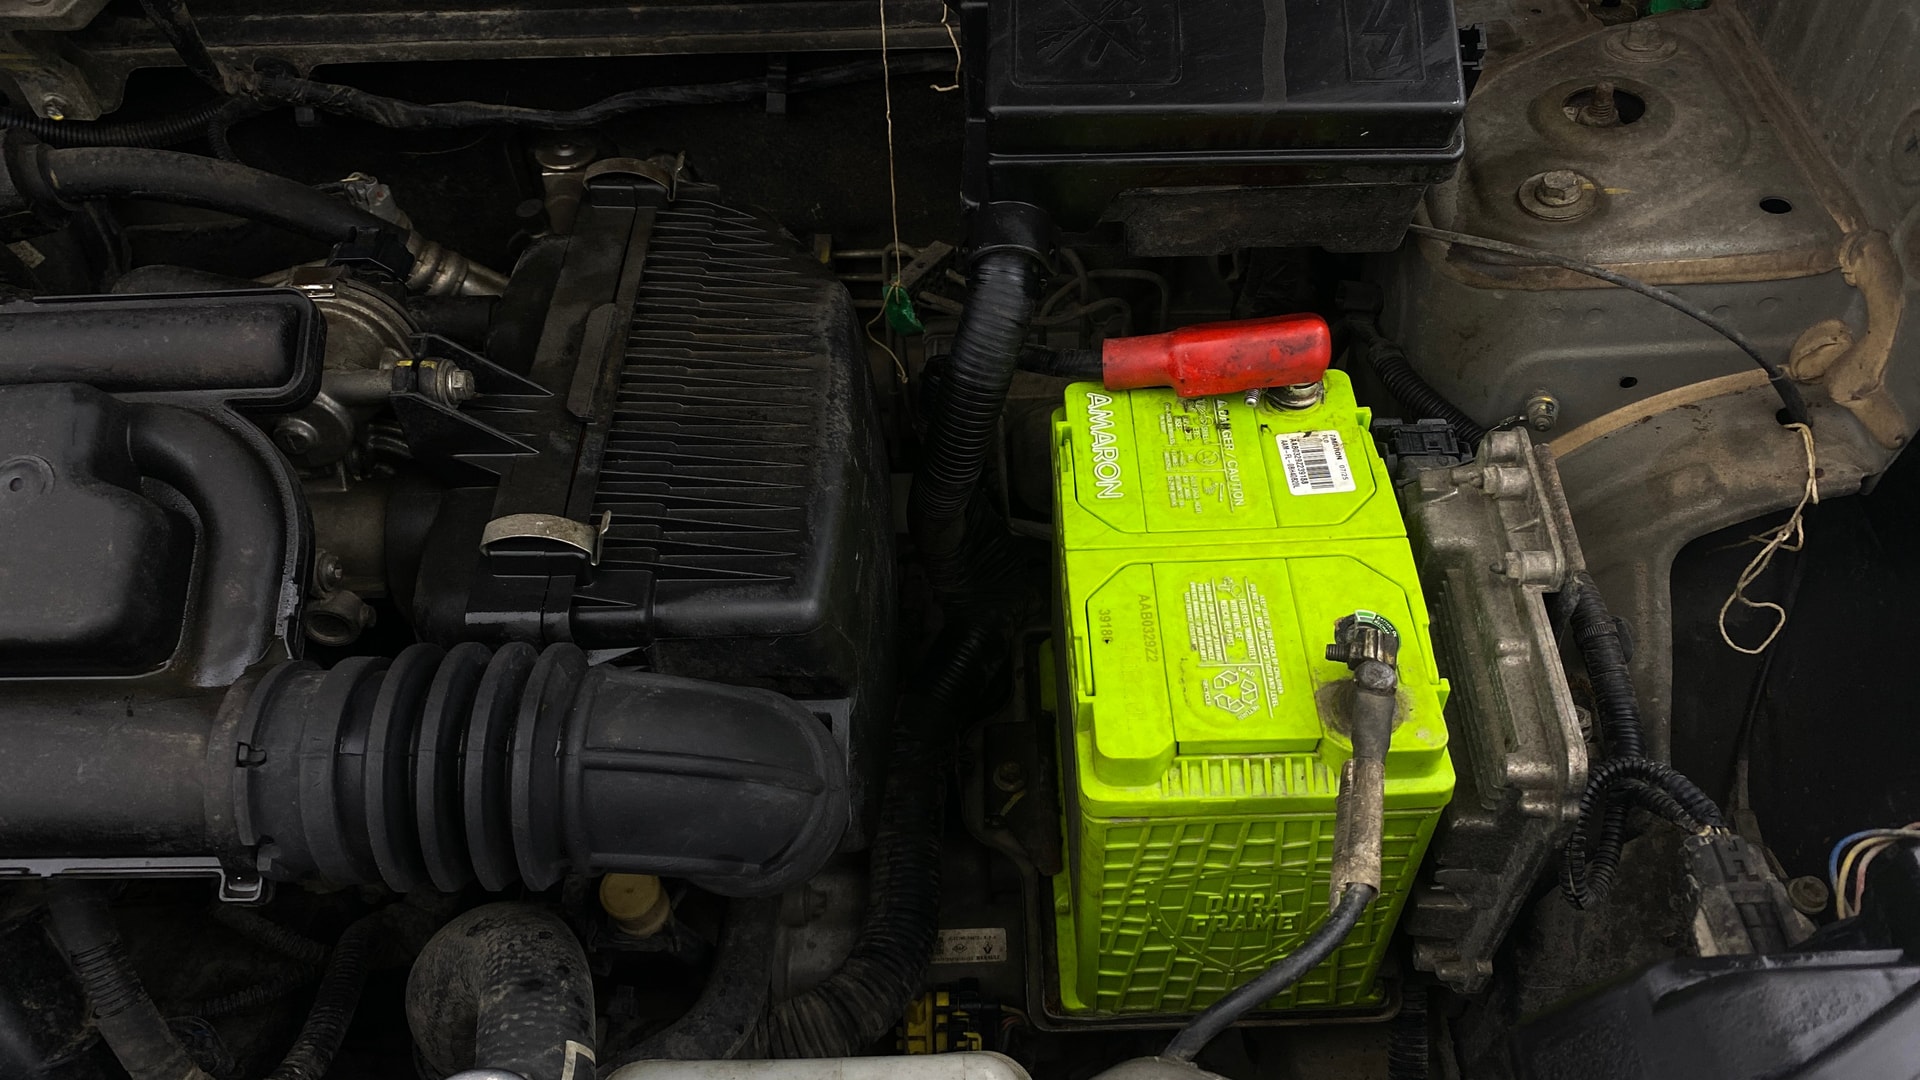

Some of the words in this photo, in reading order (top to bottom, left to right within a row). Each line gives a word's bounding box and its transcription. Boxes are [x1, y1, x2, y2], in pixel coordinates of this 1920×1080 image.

[1085, 391, 1124, 500] AMARON
[1227, 460, 1245, 506] CAUTION
[1138, 593, 1159, 663] AAB0329Z2
[1202, 680, 1212, 705] RECYCLE
[1206, 893, 1283, 912] DURA
[1190, 913, 1296, 932] FRAME
